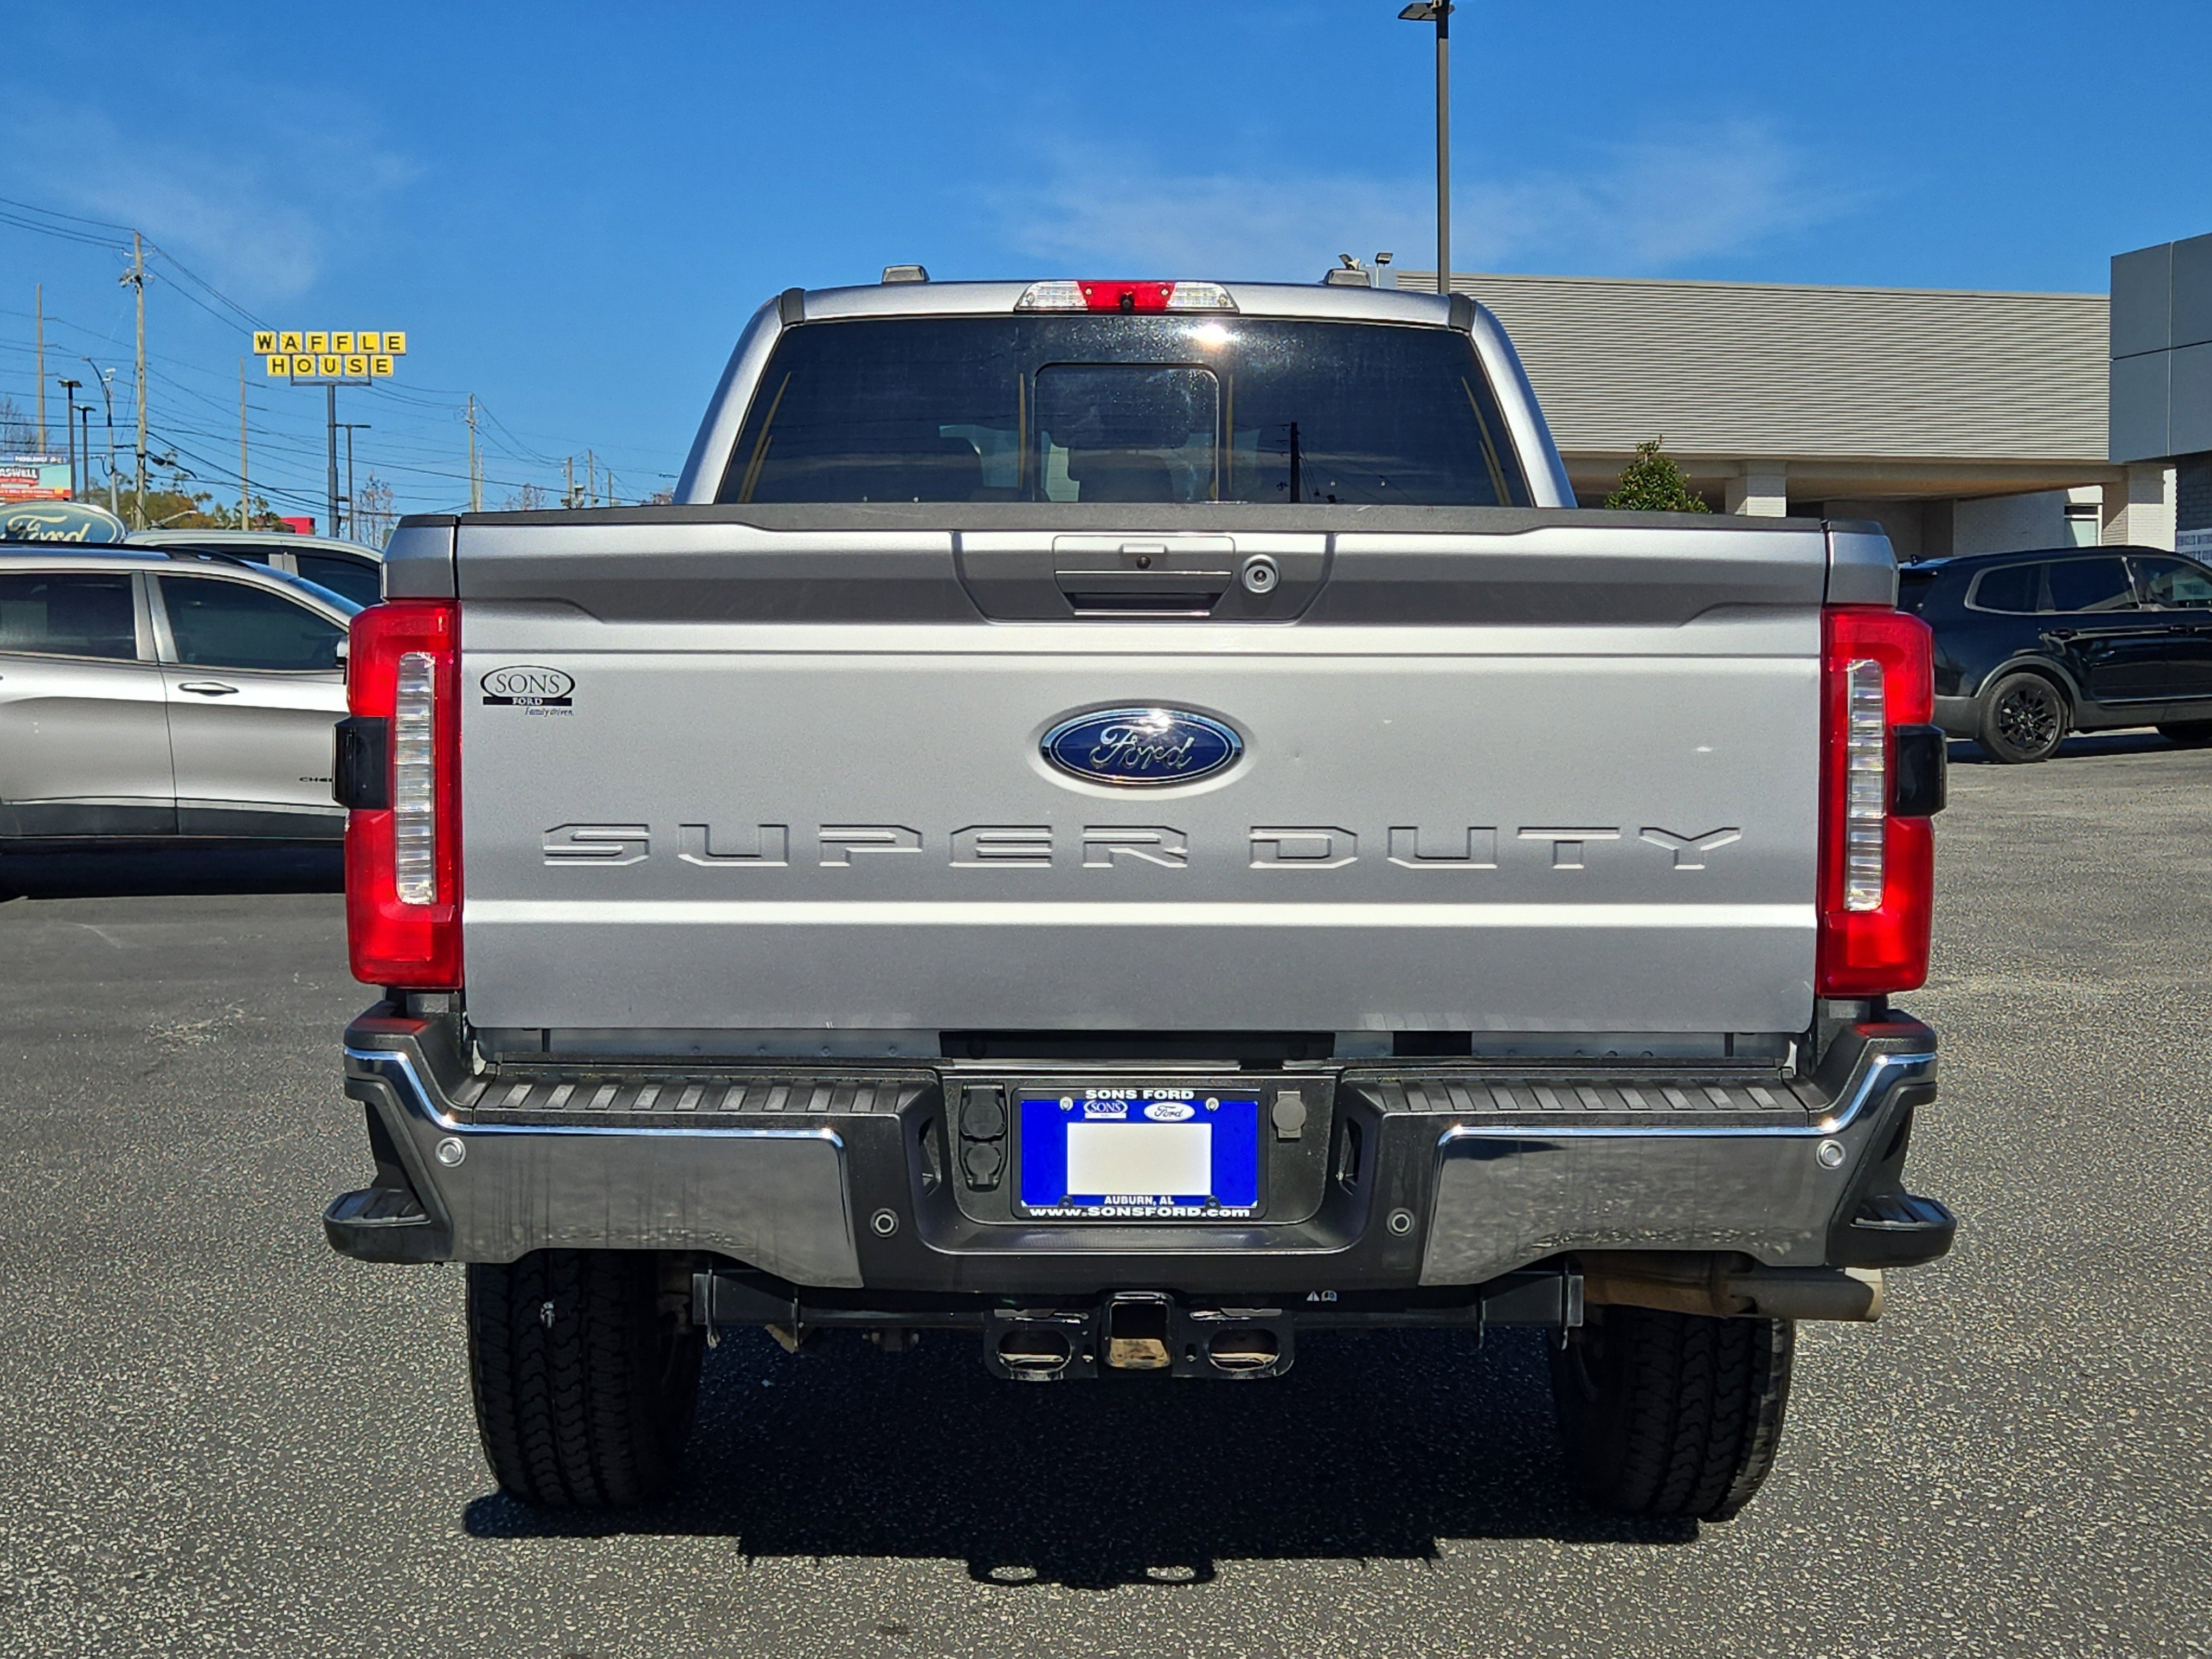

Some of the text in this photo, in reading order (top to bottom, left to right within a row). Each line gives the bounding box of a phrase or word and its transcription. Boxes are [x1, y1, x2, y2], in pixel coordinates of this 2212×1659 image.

[258, 335, 401, 350] WAFFLE
[272, 358, 388, 373] HOUSE
[495, 673, 560, 694] SONS
[512, 697, 543, 705] FORD
[1090, 725, 1195, 770] Ford
[543, 824, 1741, 870] SUPER DUTY
[1085, 1090, 1194, 1099] SONS FORD
[1091, 1102, 1121, 1113] SONS
[1154, 1105, 1185, 1117] Ford
[1104, 1195, 1175, 1206] AUBURN, AL
[1030, 1207, 1250, 1217] www.SONSFORD.com
